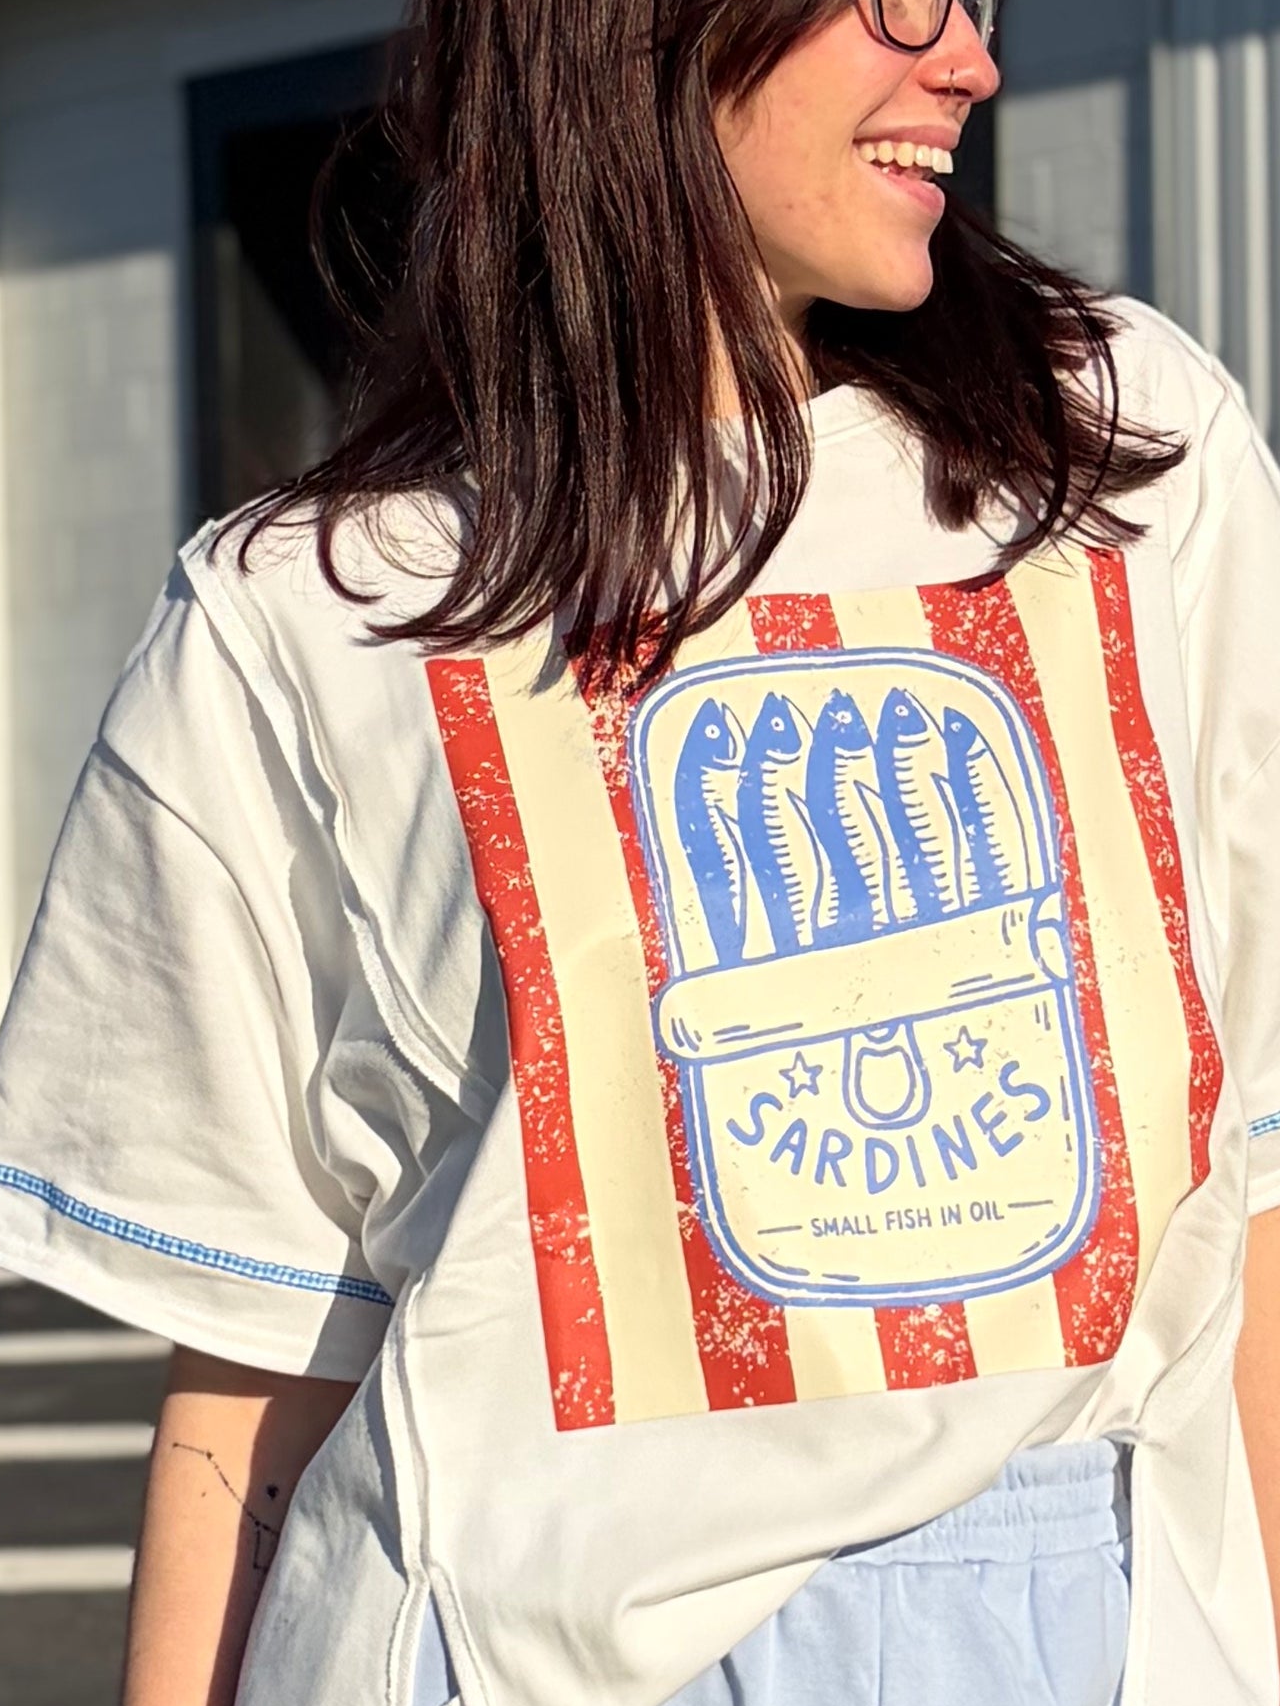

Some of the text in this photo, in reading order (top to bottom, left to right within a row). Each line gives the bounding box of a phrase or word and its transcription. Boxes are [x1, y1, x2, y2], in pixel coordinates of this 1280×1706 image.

[726, 1060, 1051, 1195] SARDINES
[810, 1200, 1005, 1238] SMALL FISH IN OIL
